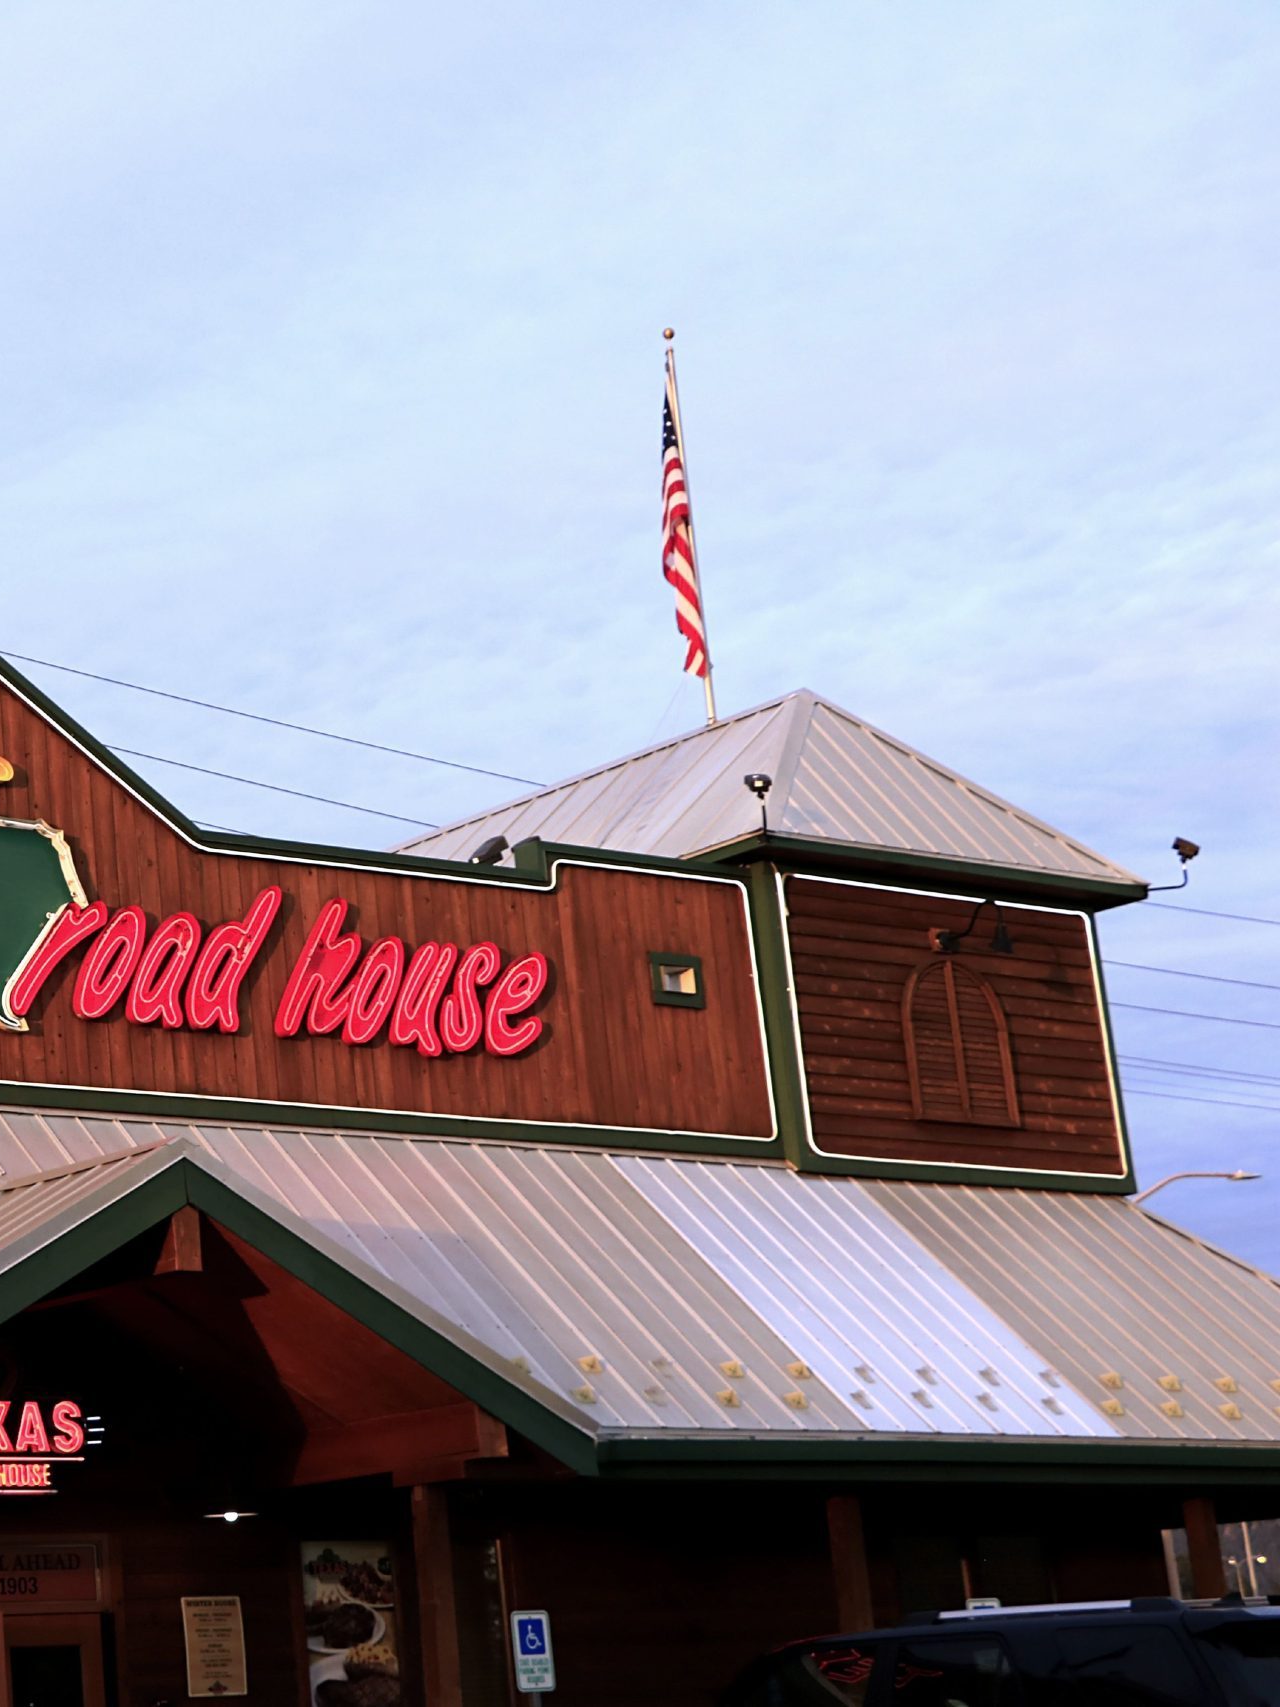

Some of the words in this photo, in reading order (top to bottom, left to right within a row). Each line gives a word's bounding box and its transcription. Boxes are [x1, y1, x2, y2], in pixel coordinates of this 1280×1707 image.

[10, 886, 283, 1035] road
[274, 899, 548, 1057] house
[12, 1553, 81, 1571] AHEAD
